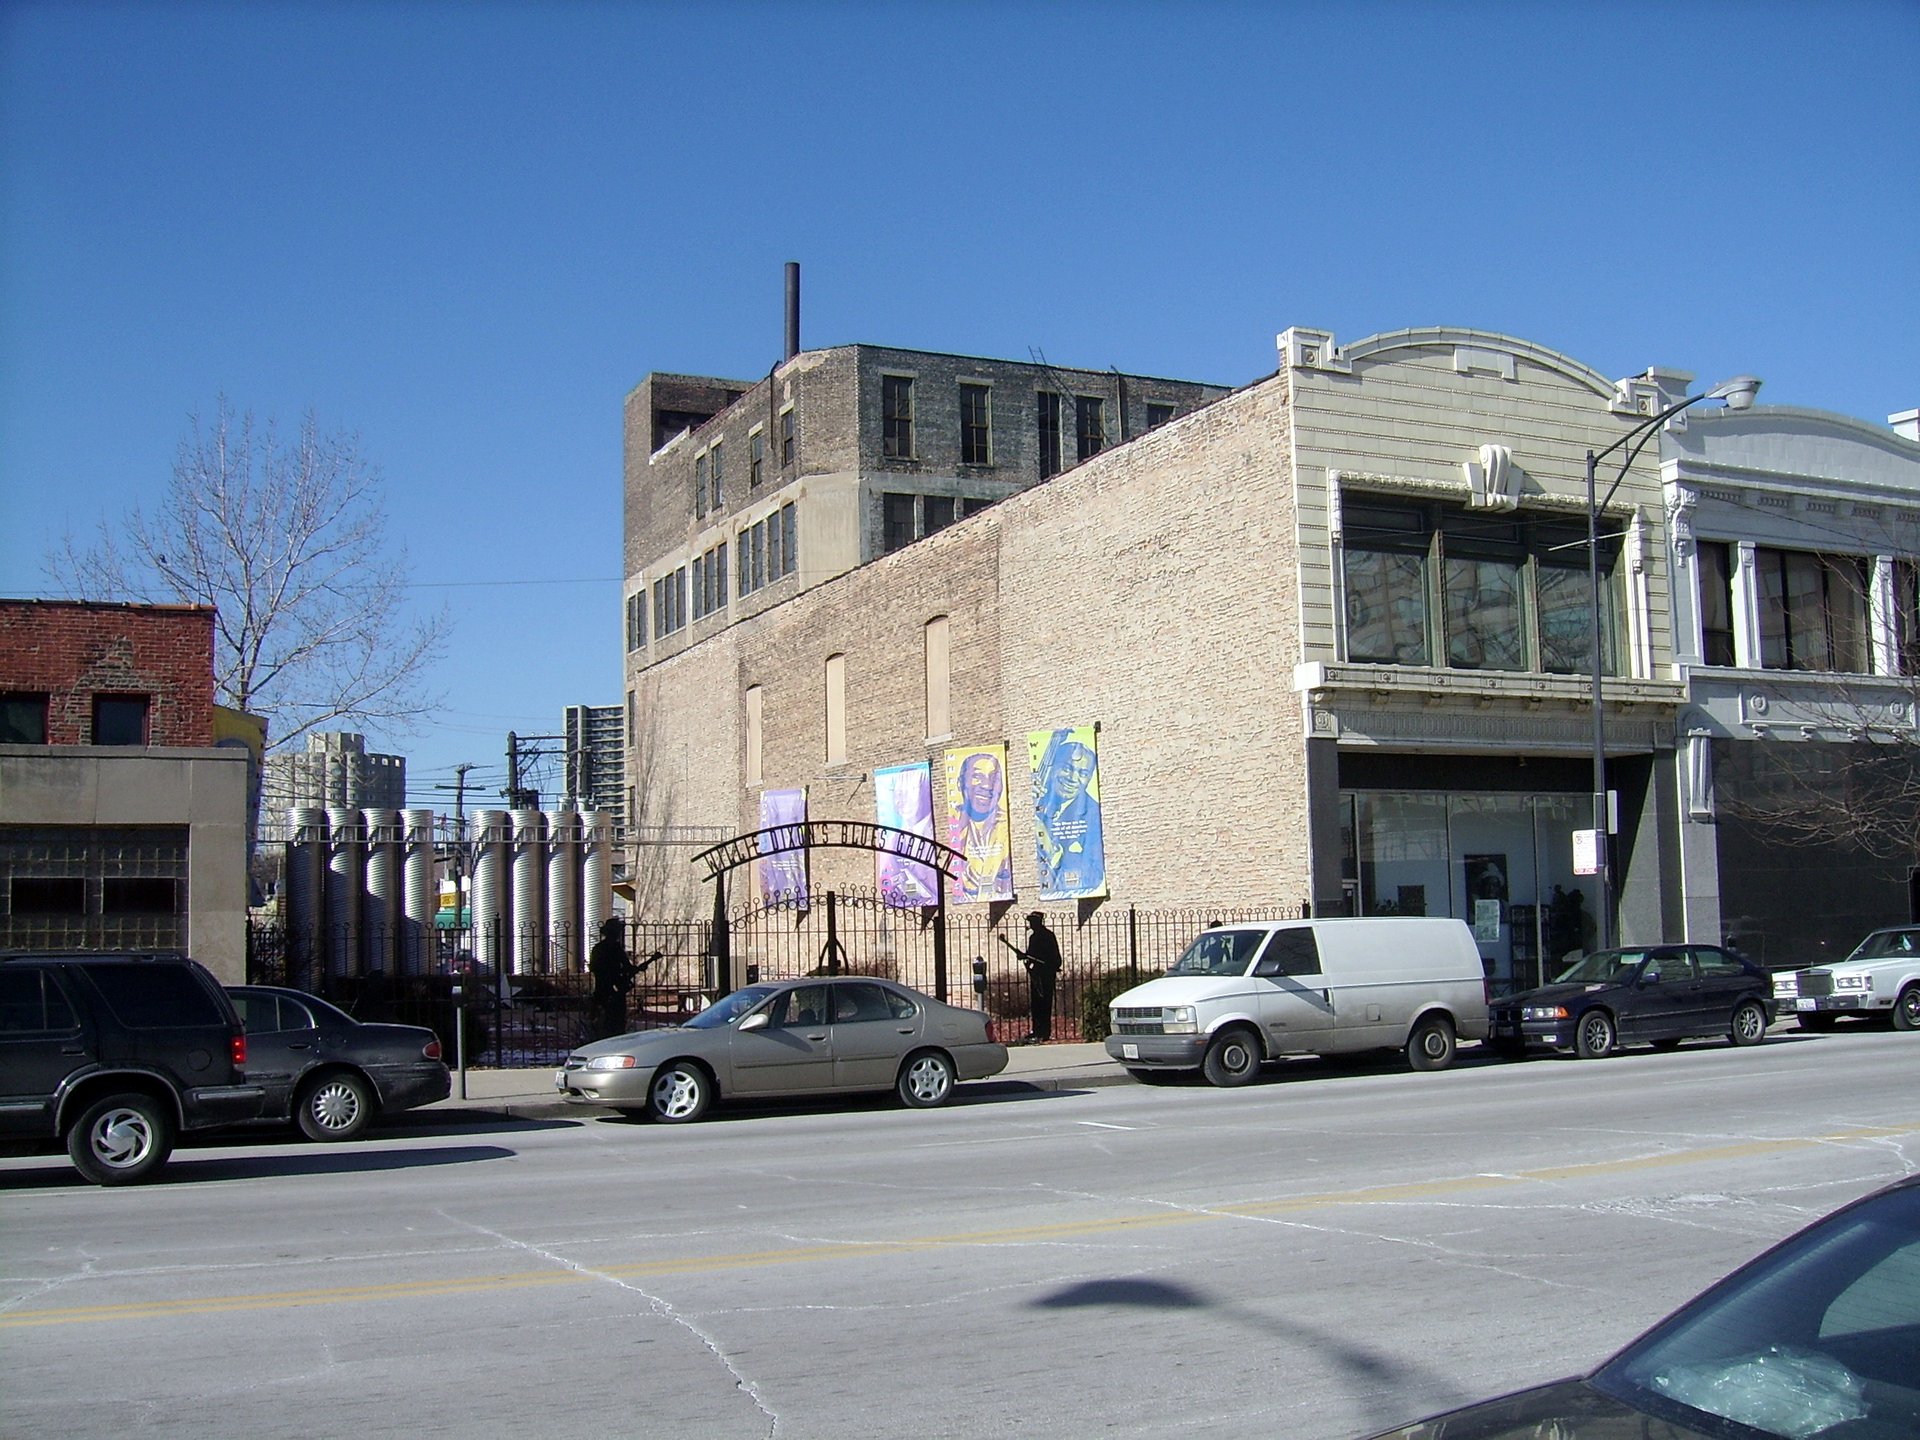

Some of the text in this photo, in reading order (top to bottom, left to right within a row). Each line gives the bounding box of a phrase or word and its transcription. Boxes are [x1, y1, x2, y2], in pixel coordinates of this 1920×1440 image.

[702, 833, 762, 874] WILLIE
[769, 823, 829, 850] DIXON'S
[841, 823, 887, 849] BLUES
[896, 833, 956, 872] GARDEN
[1038, 831, 1050, 889] DIXON
